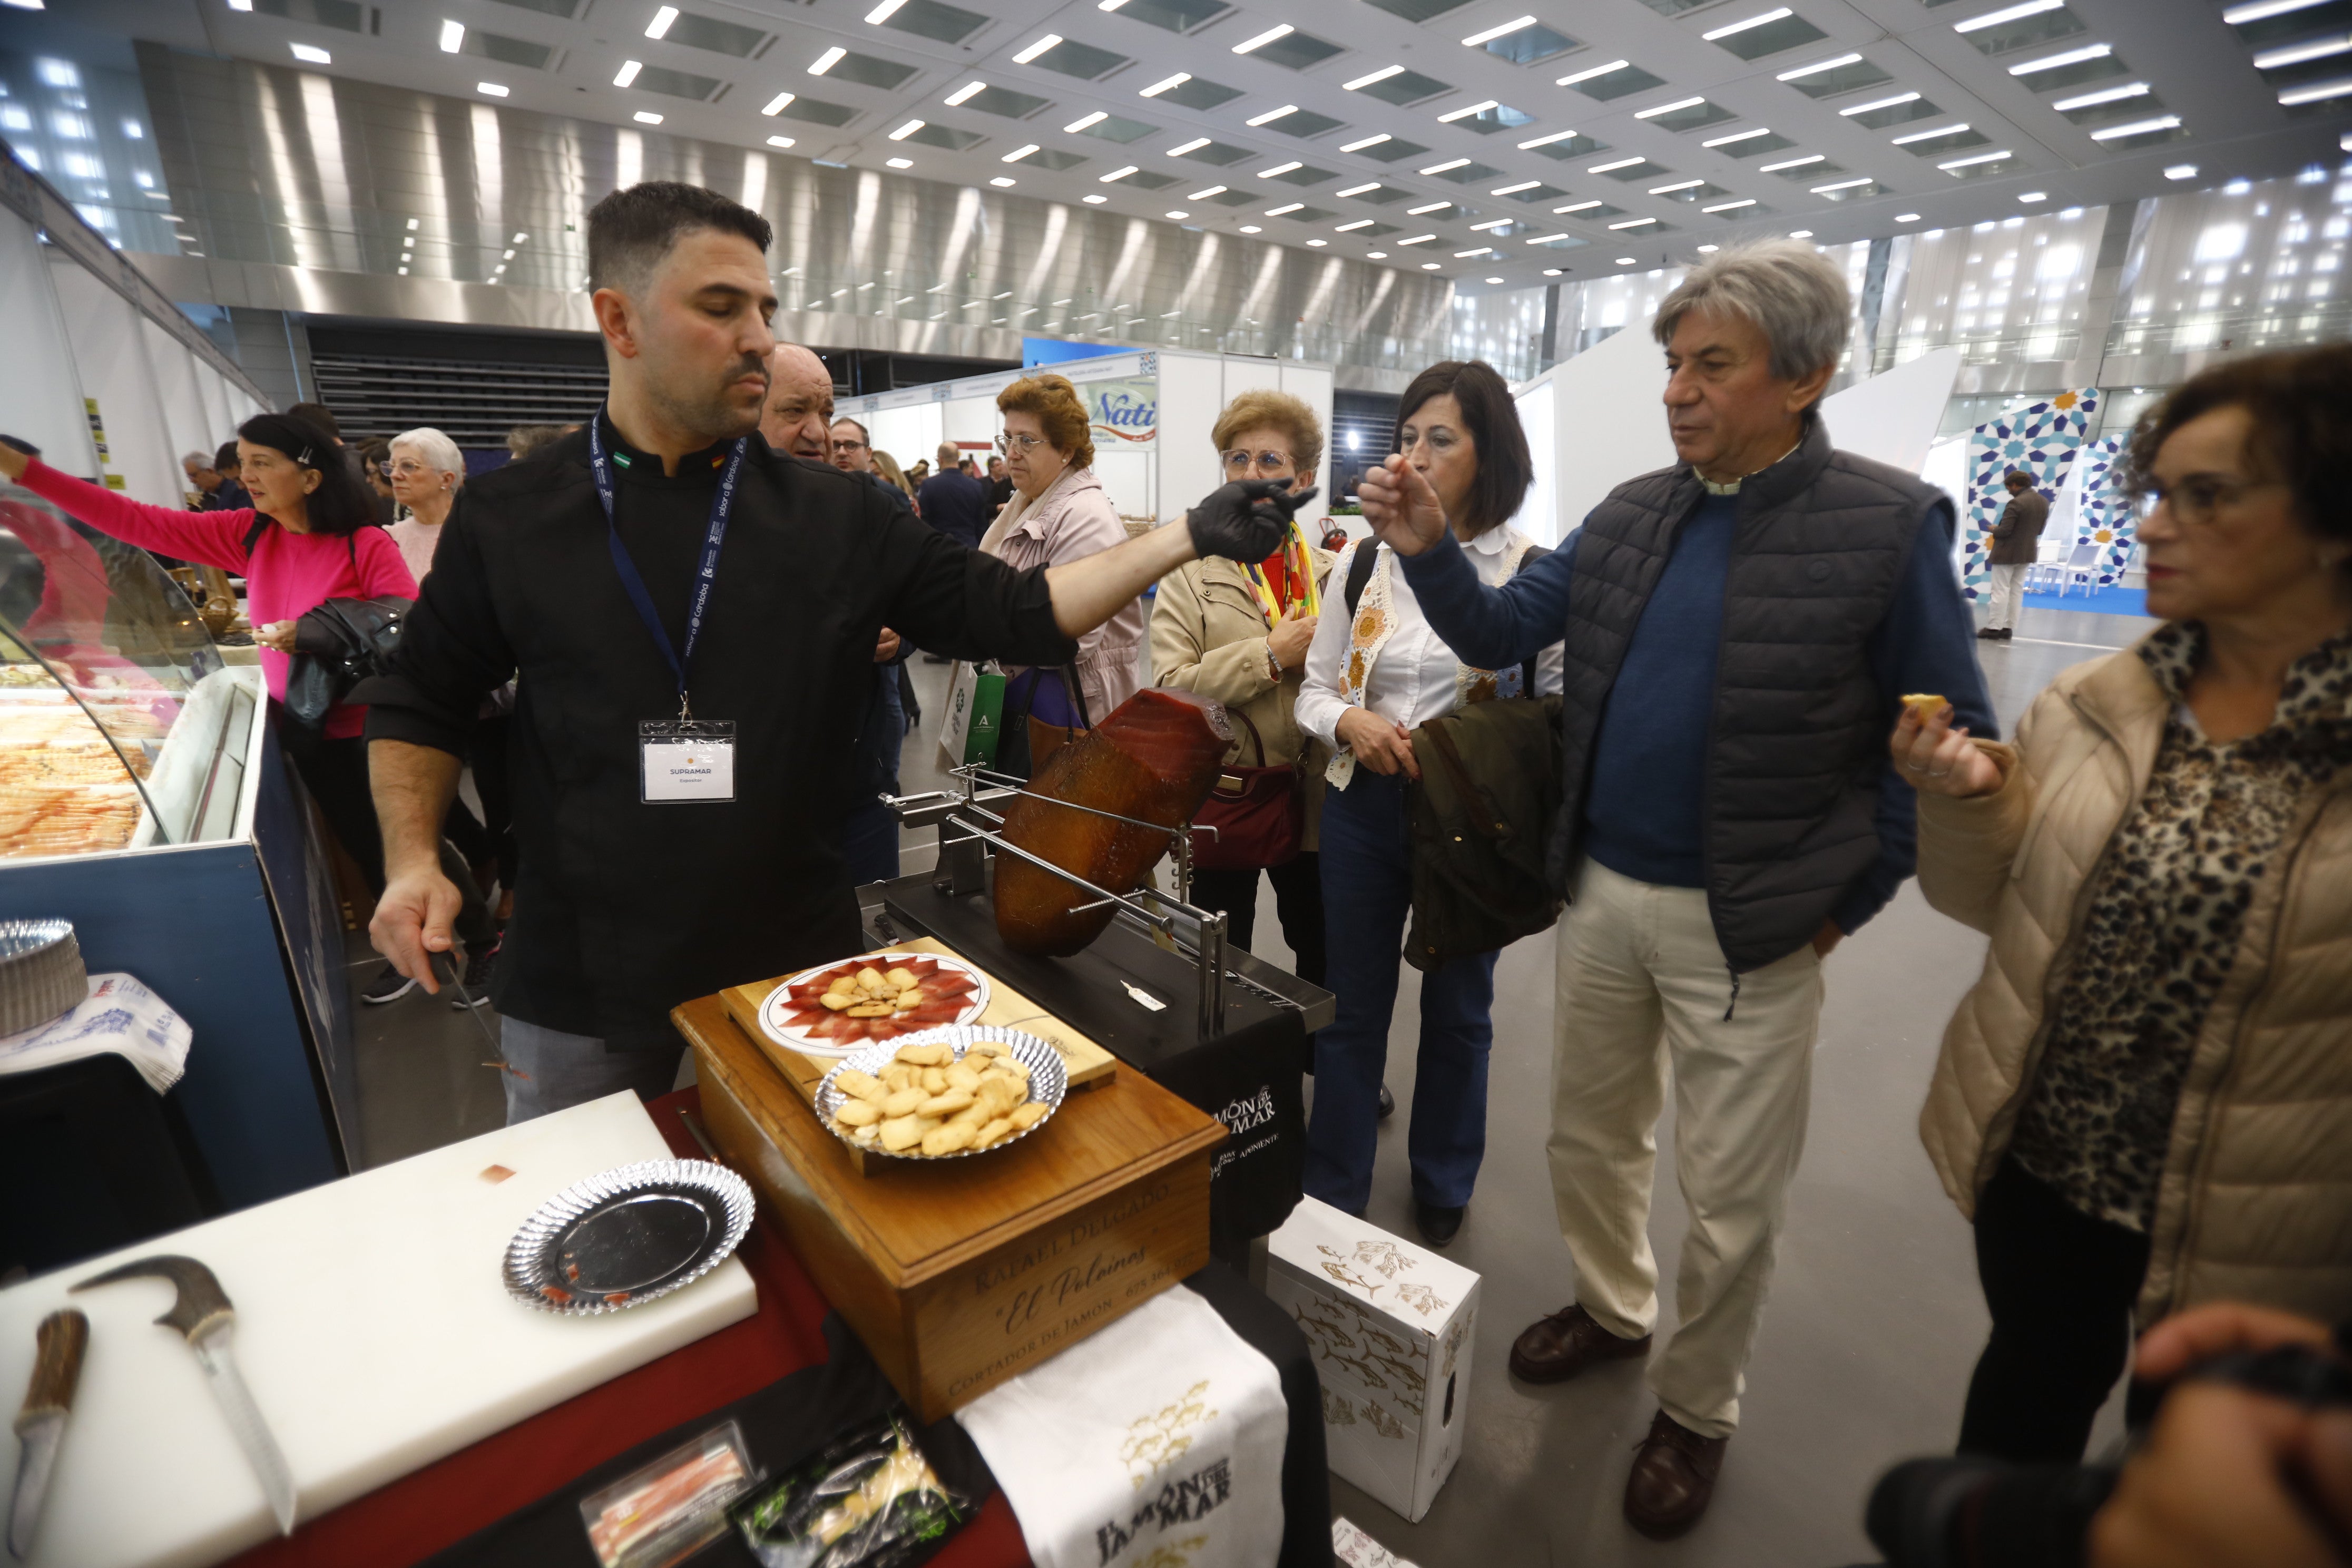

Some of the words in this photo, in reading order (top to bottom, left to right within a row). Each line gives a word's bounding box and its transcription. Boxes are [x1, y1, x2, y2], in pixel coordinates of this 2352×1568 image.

[1089, 393, 1155, 426] Nati
[719, 497, 728, 517] sabor
[694, 583, 709, 618] Córdoba
[1231, 1101, 1276, 1134] MAR
[975, 1241, 1063, 1295] RAFAEL
[1069, 1184, 1170, 1248] DELGADO
[949, 1340, 1037, 1398] CORTADOR
[1041, 1327, 1061, 1346] DE
[1064, 1298, 1113, 1334] JAMON
[1126, 1279, 1147, 1297] 675
[1159, 1478, 1231, 1532] MAR
